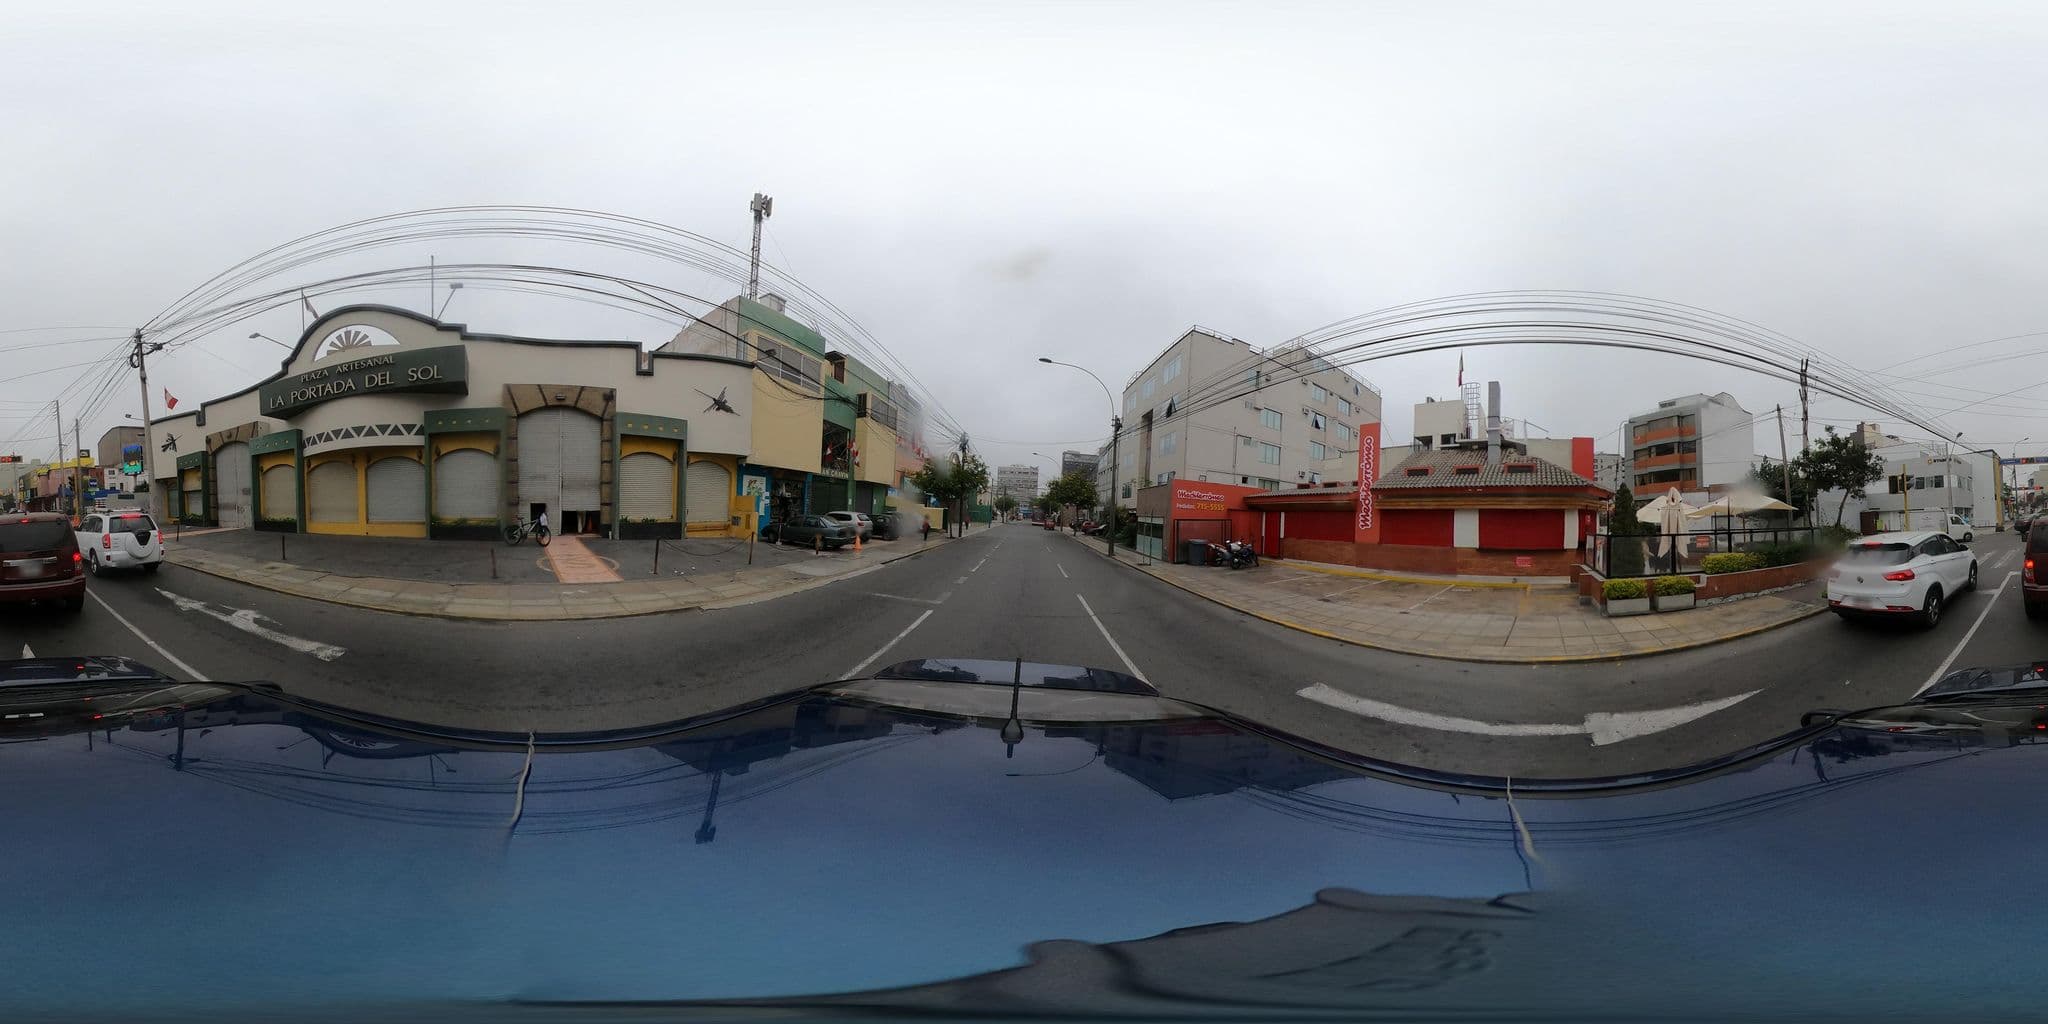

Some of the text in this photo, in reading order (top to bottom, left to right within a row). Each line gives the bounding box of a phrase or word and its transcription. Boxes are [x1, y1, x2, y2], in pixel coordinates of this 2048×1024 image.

[270, 365, 443, 409] LA PORTADA DEL SOL
[301, 355, 395, 383] PLAZA ARTESANAL
